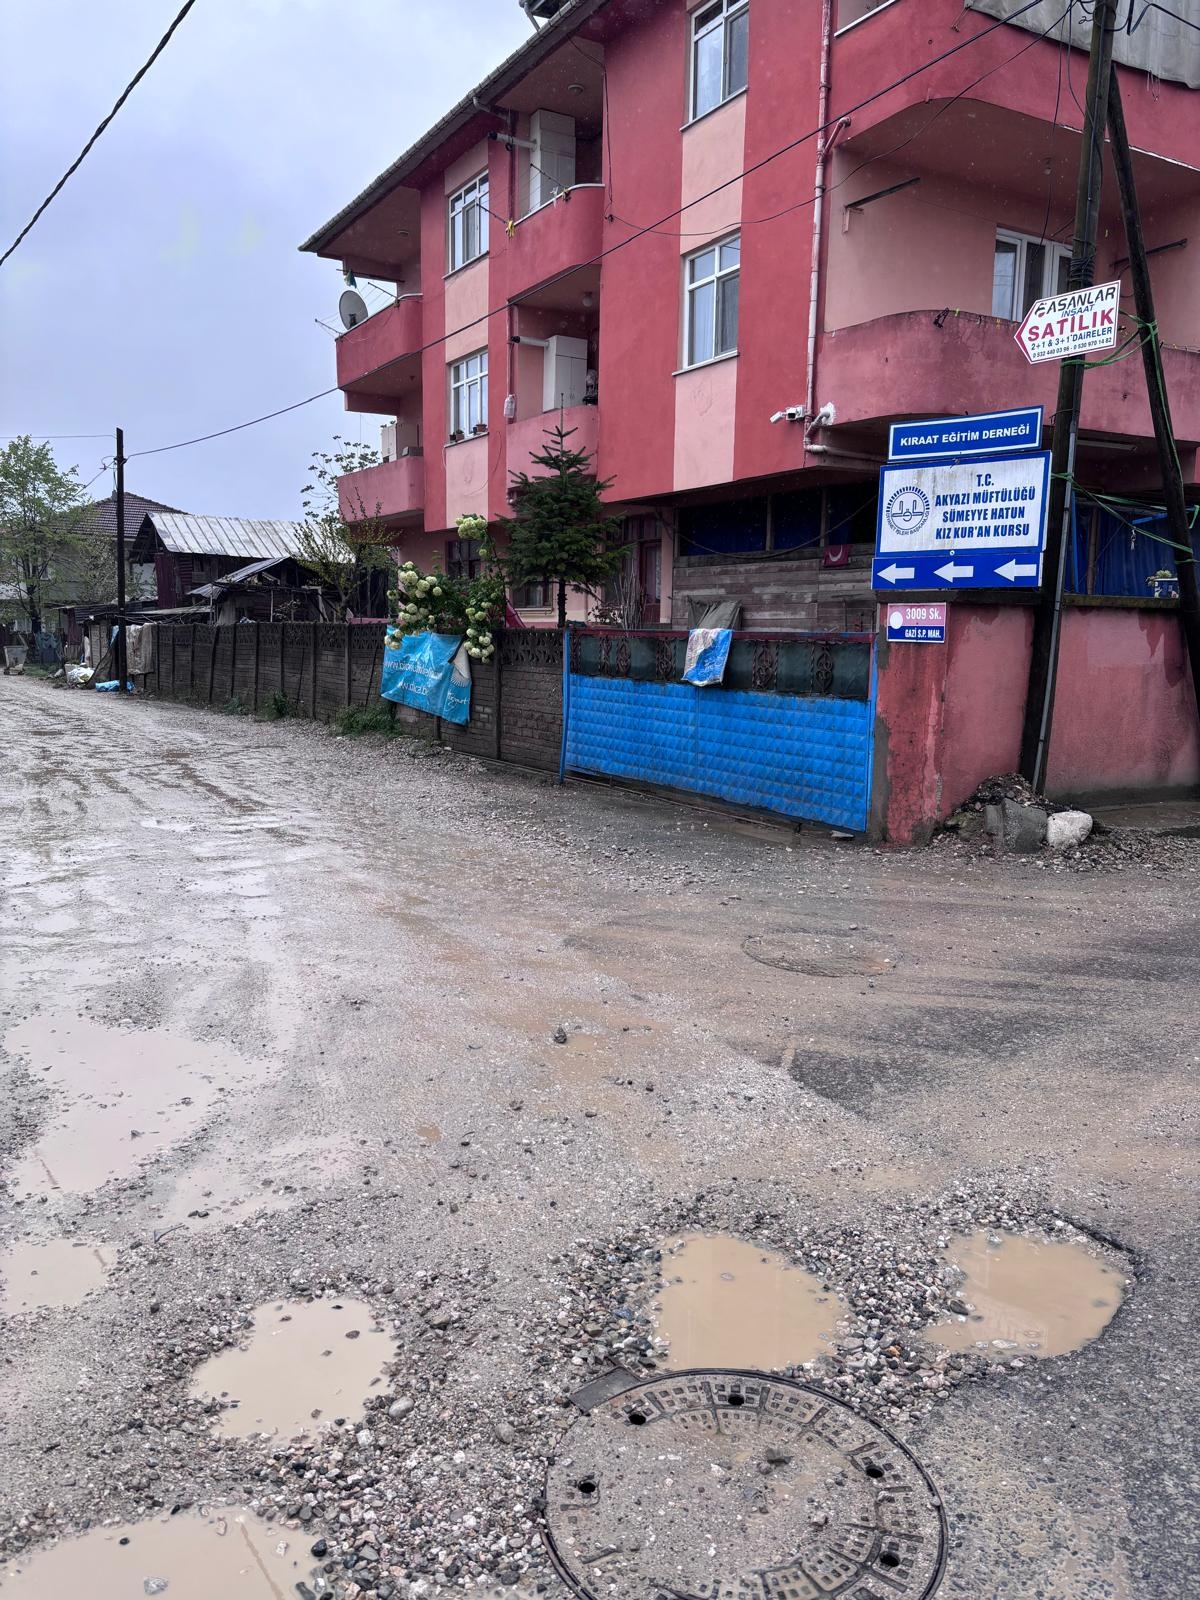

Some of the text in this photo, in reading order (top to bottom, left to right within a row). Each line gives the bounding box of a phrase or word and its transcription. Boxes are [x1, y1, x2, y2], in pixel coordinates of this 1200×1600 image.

[1028, 308, 1115, 342] SATILIK
[1031, 341, 1046, 351] 2+1
[1047, 339, 1053, 347] &
[900, 423, 1030, 446] KIRAAT EĞİTİM DERNEĞİ
[976, 473, 994, 487] T.C.
[935, 486, 1036, 507] AKYAZI MÜFTÜLÜĞÜ
[942, 506, 1026, 523] SÜMEYYE HATUN
[935, 523, 1030, 540] KIZ KUR'AN KURSU
[905, 607, 942, 620] 3009 Sk.
[904, 627, 917, 638] GAZİ
[927, 629, 942, 638] MAH.
